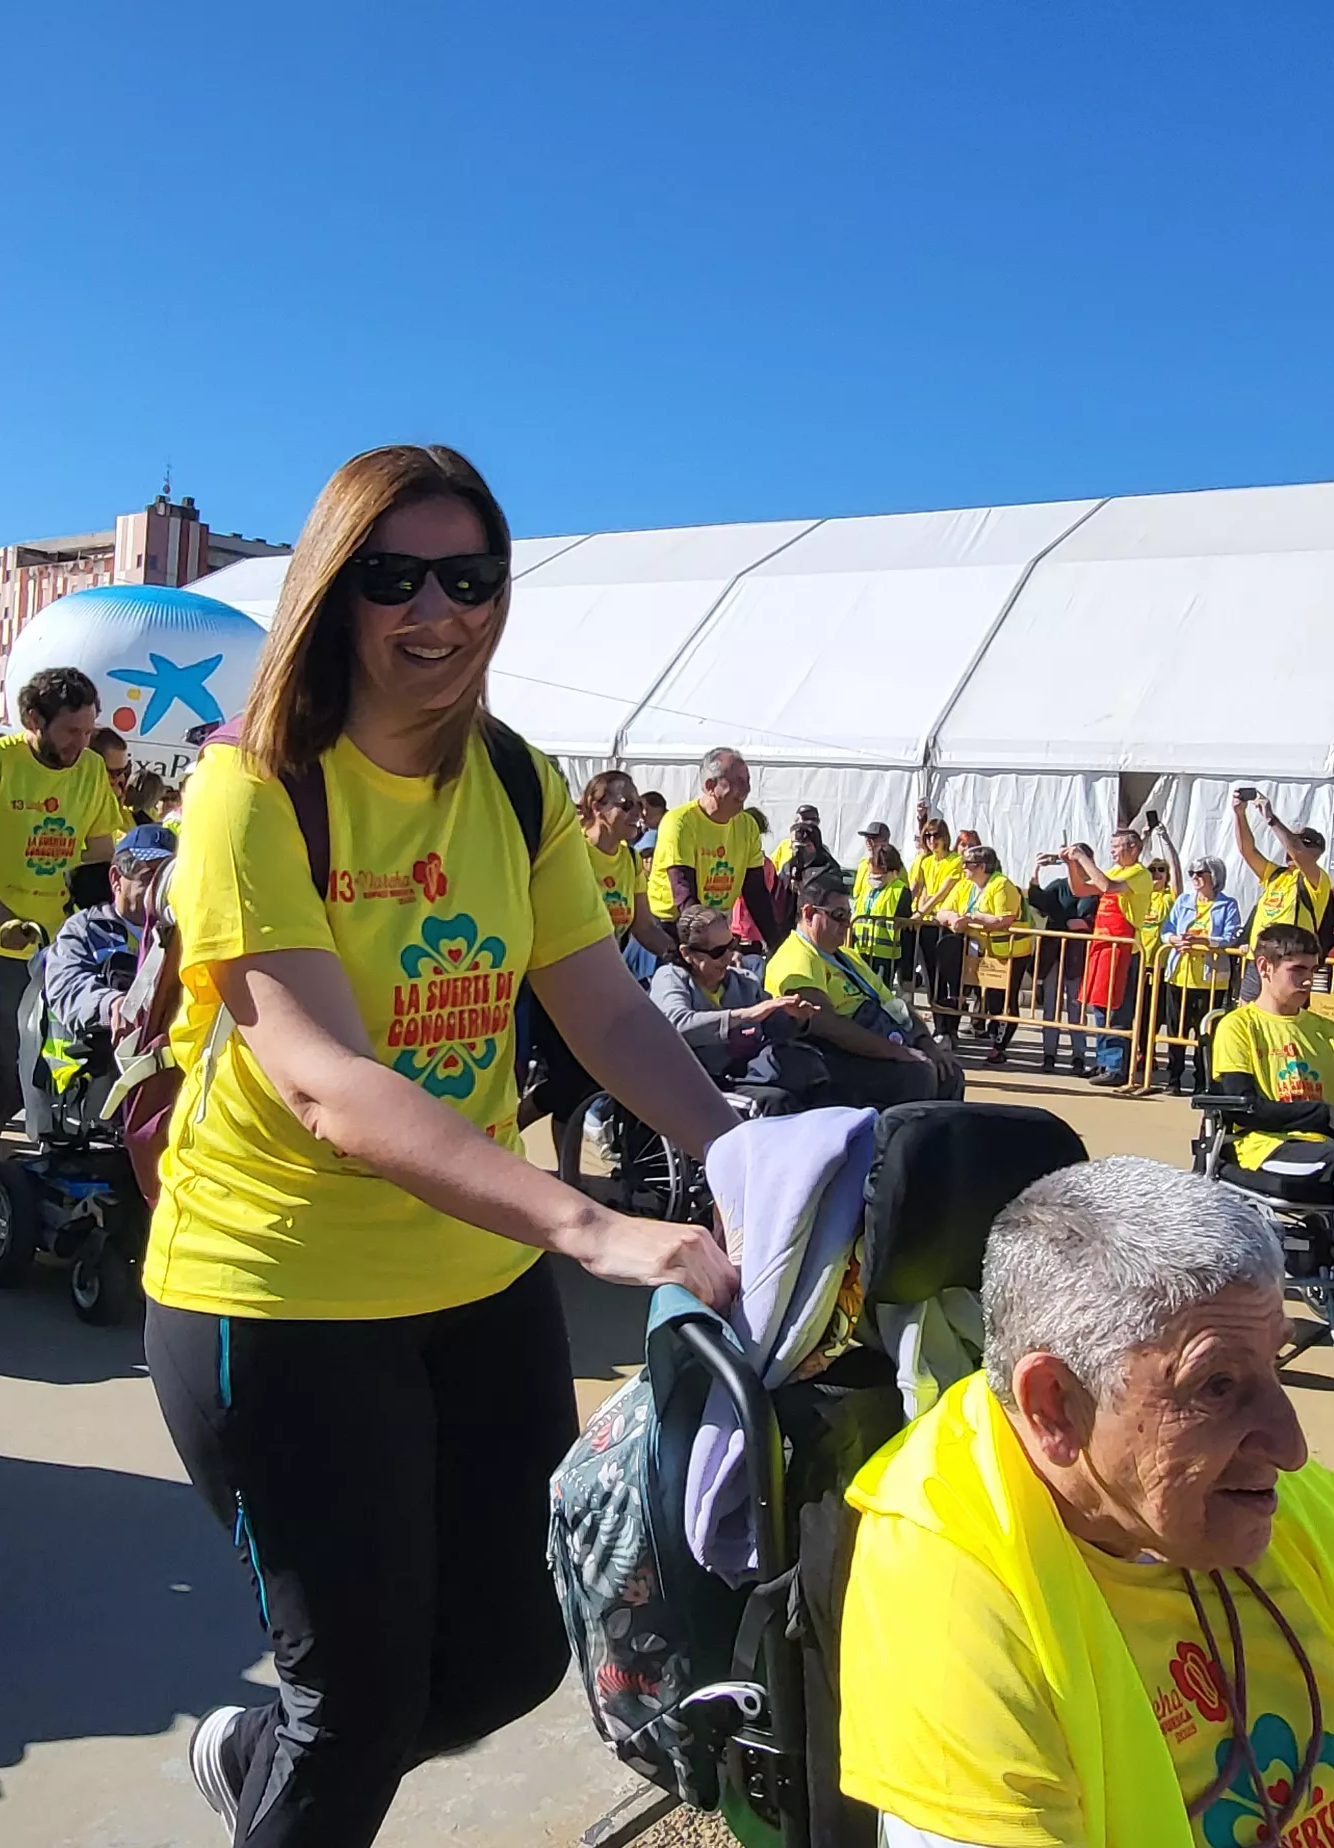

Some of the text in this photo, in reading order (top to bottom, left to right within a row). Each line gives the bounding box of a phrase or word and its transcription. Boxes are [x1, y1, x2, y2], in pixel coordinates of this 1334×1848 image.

[11, 799, 24, 811] 13
[330, 870, 356, 903] 13
[393, 983, 421, 1017] LA
[425, 973, 491, 1013] SUERTE
[387, 1002, 512, 1047] CONOCERNOS
